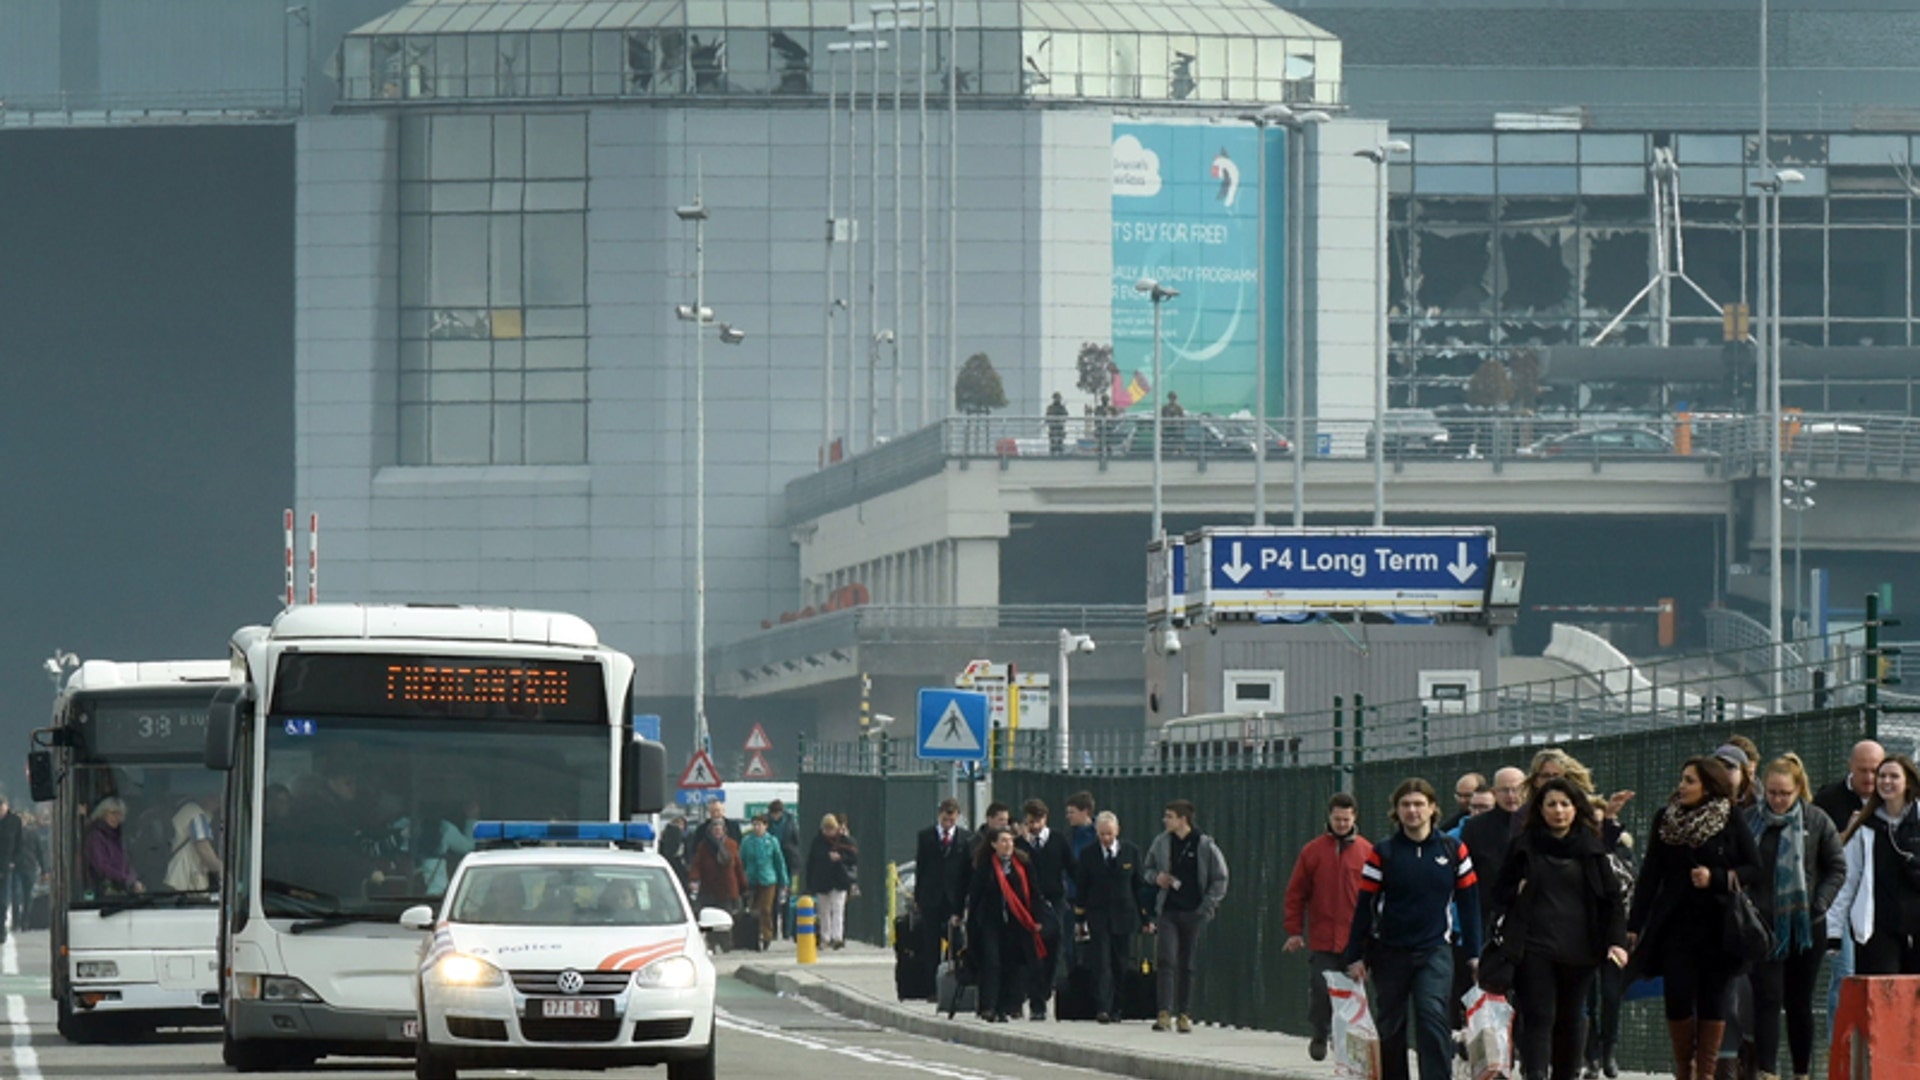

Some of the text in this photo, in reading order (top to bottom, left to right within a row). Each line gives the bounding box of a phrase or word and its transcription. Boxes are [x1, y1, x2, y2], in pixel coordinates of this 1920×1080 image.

[1160, 222, 1189, 243] FOR
[1260, 548, 1438, 577] P4 Long Term
